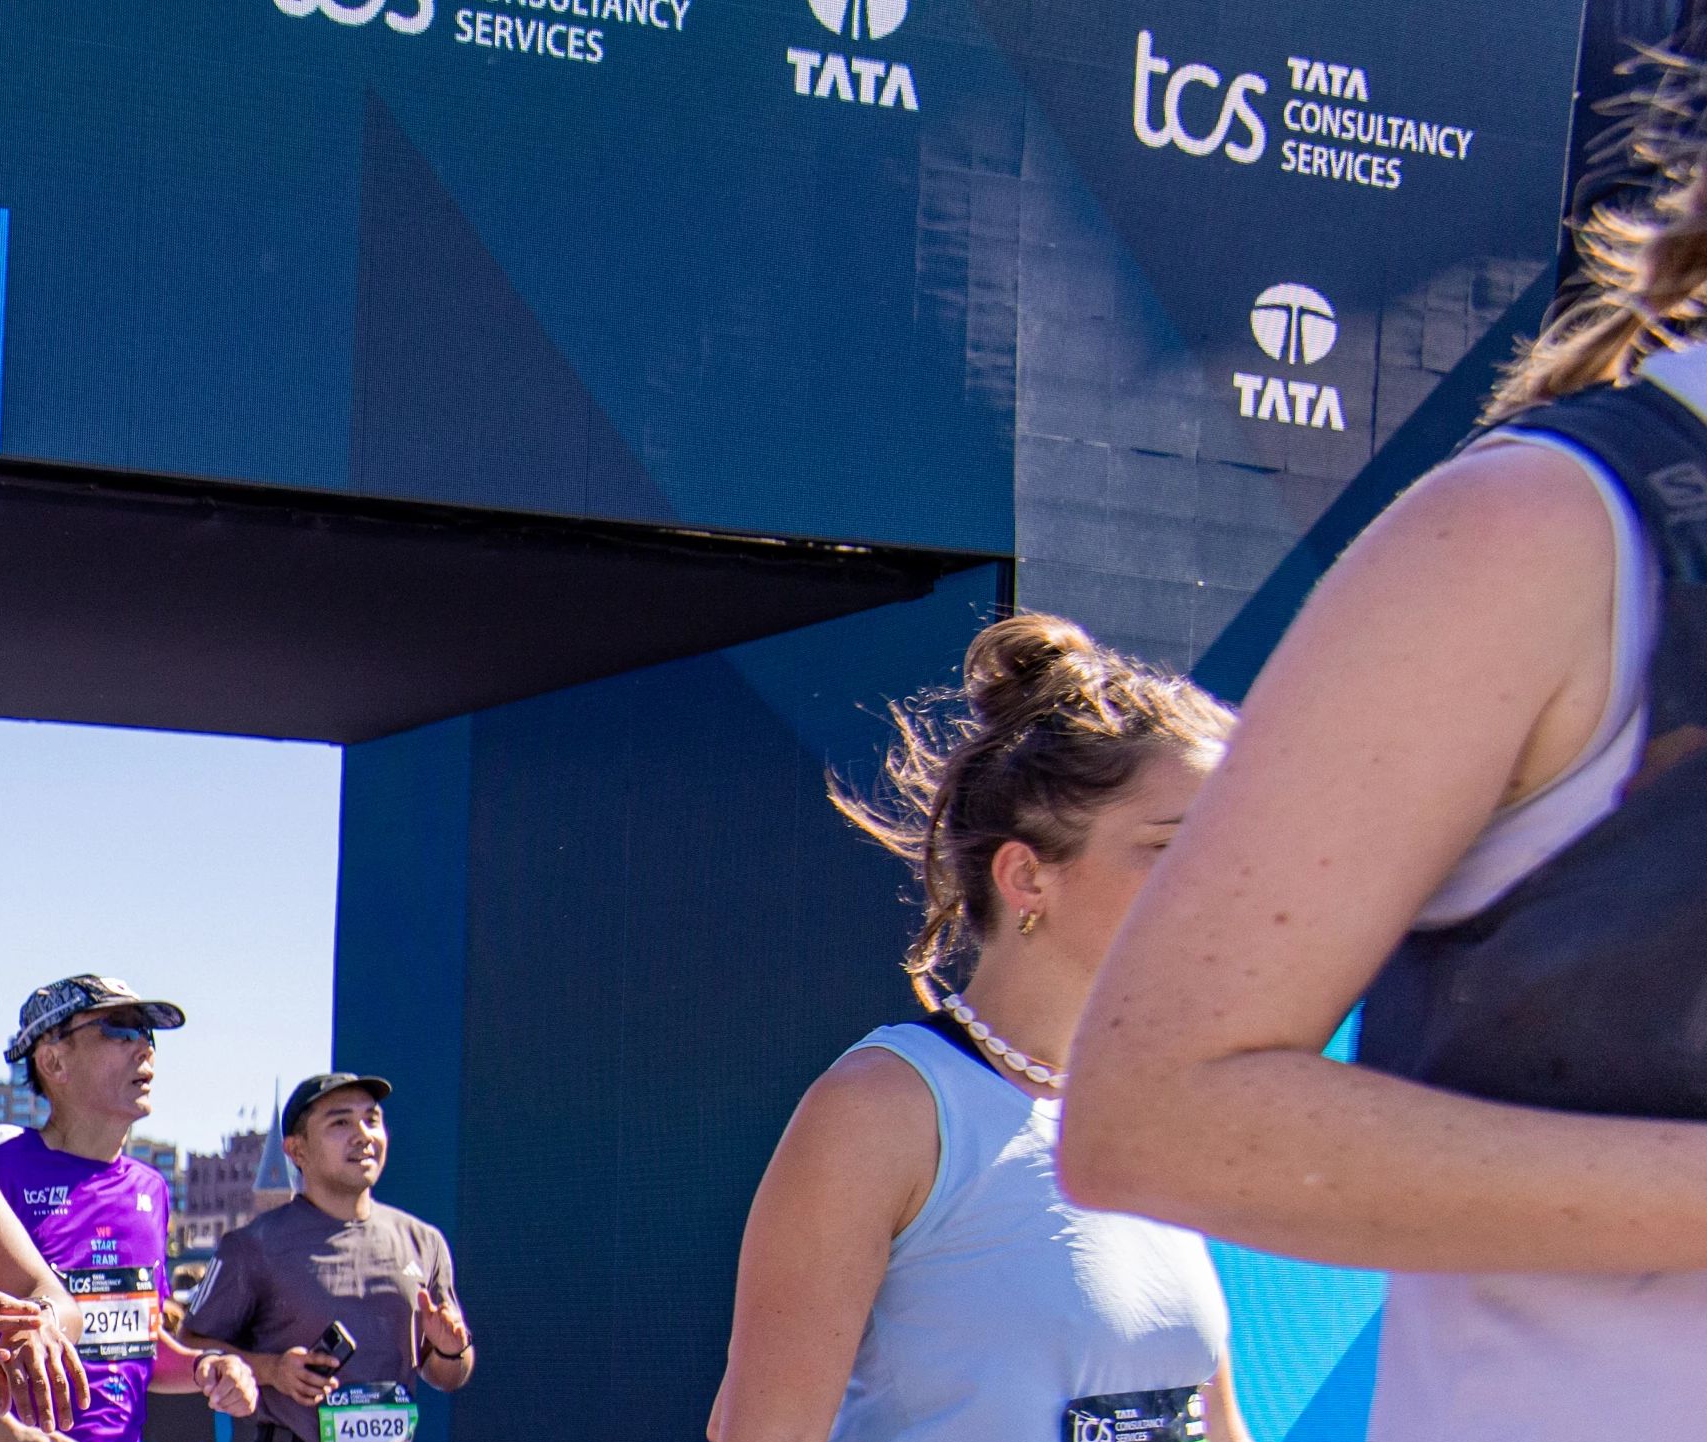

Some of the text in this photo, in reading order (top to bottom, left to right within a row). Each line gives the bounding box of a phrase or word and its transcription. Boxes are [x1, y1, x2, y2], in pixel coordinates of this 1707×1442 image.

[454, 8, 605, 63] SERVICES
[787, 48, 919, 112] TATA
[1133, 29, 1268, 164] tcs
[1287, 56, 1369, 101] TATA
[1283, 100, 1474, 160] CONSULTANCY
[1281, 140, 1403, 190] SERVICES
[1232, 372, 1345, 432] TATA
[91, 1239, 117, 1251] START
[92, 1253, 118, 1266] TRAIN
[69, 1275, 91, 1293] tcs
[84, 1309, 140, 1335] 29741
[340, 1417, 404, 1439] 40628
